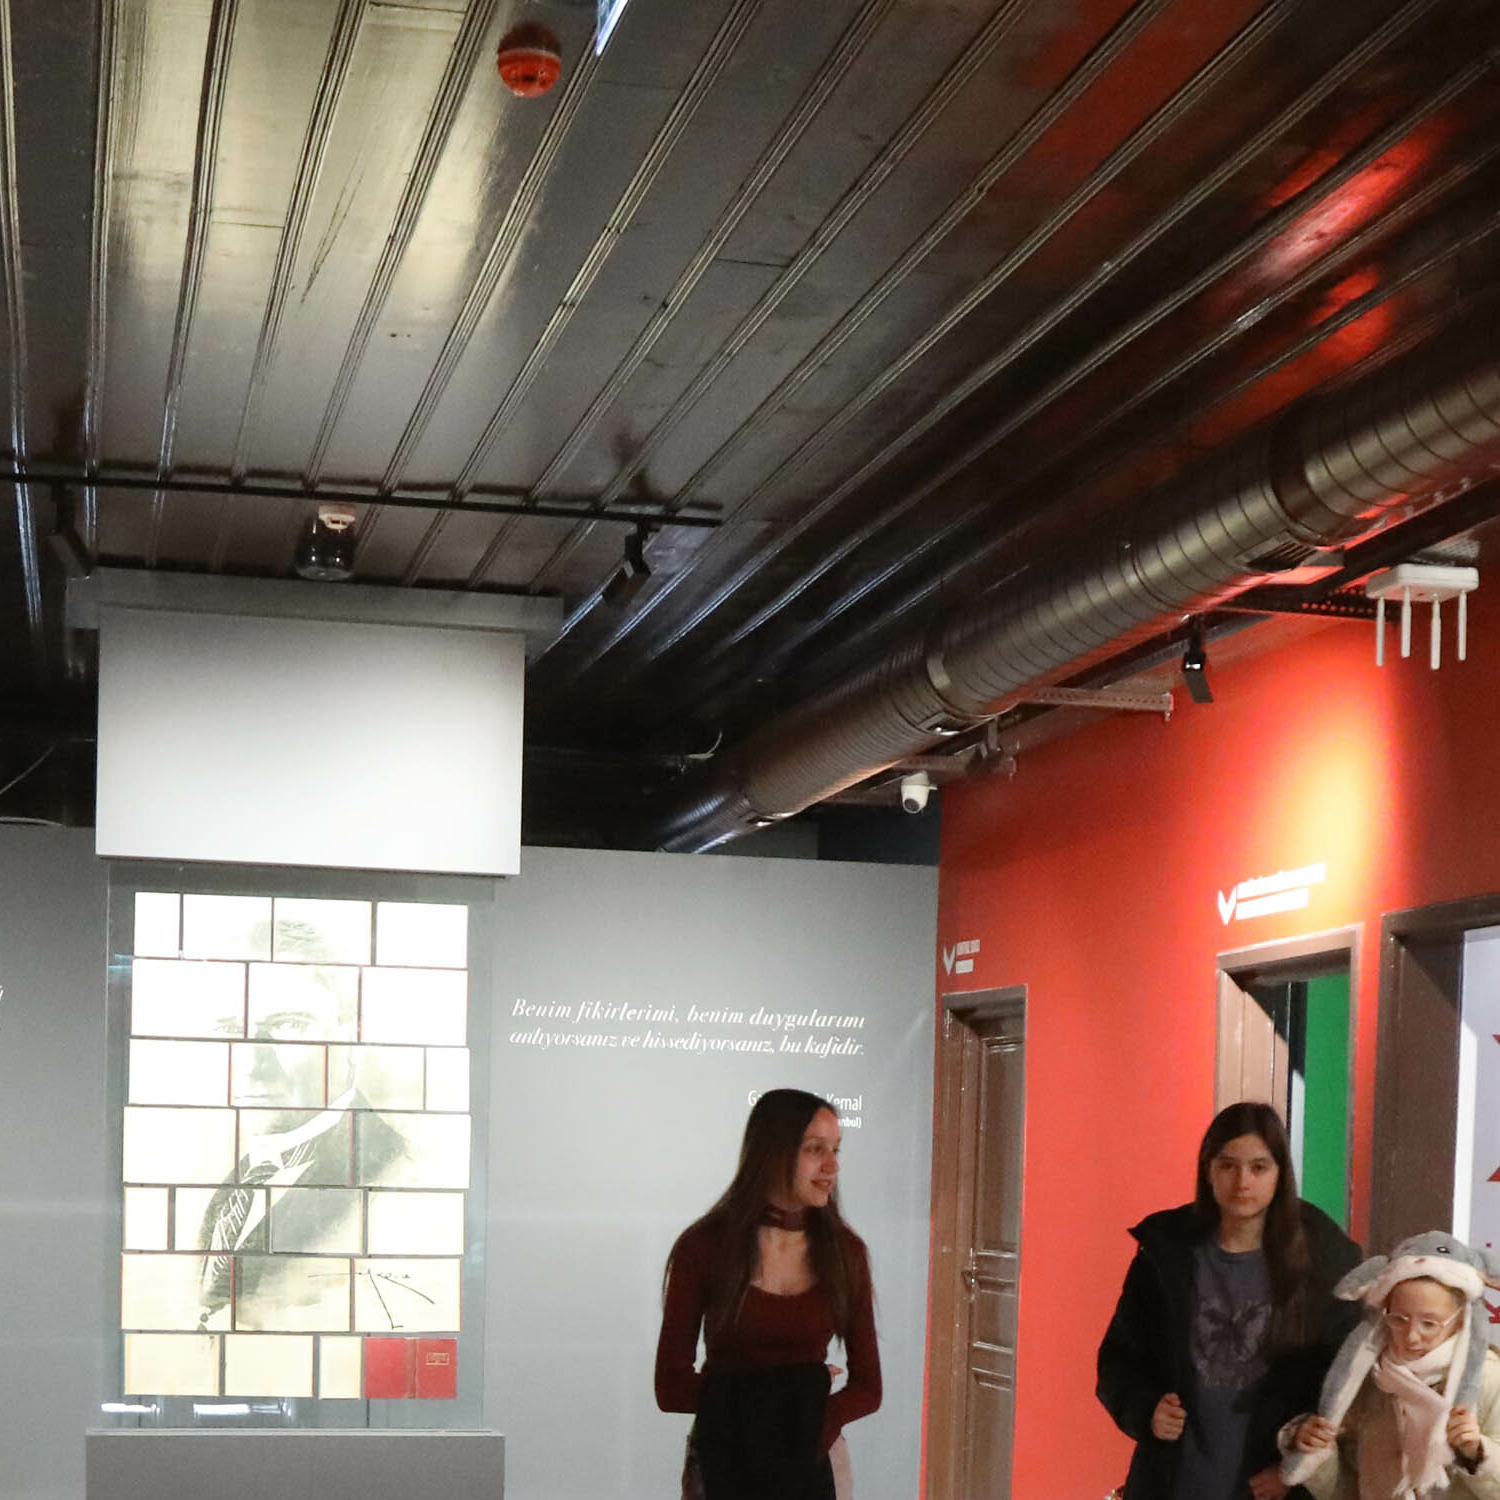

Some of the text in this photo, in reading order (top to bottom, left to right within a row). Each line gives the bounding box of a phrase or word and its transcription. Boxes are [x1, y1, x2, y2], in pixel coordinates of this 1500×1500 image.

[512, 998, 865, 1032] Benim fikirlerimi, benim duygularımı
[508, 1027, 618, 1051] anlıyorsanız
[621, 1034, 641, 1048] ve
[779, 1034, 802, 1054] bu
[803, 1034, 865, 1059] kafidir.
